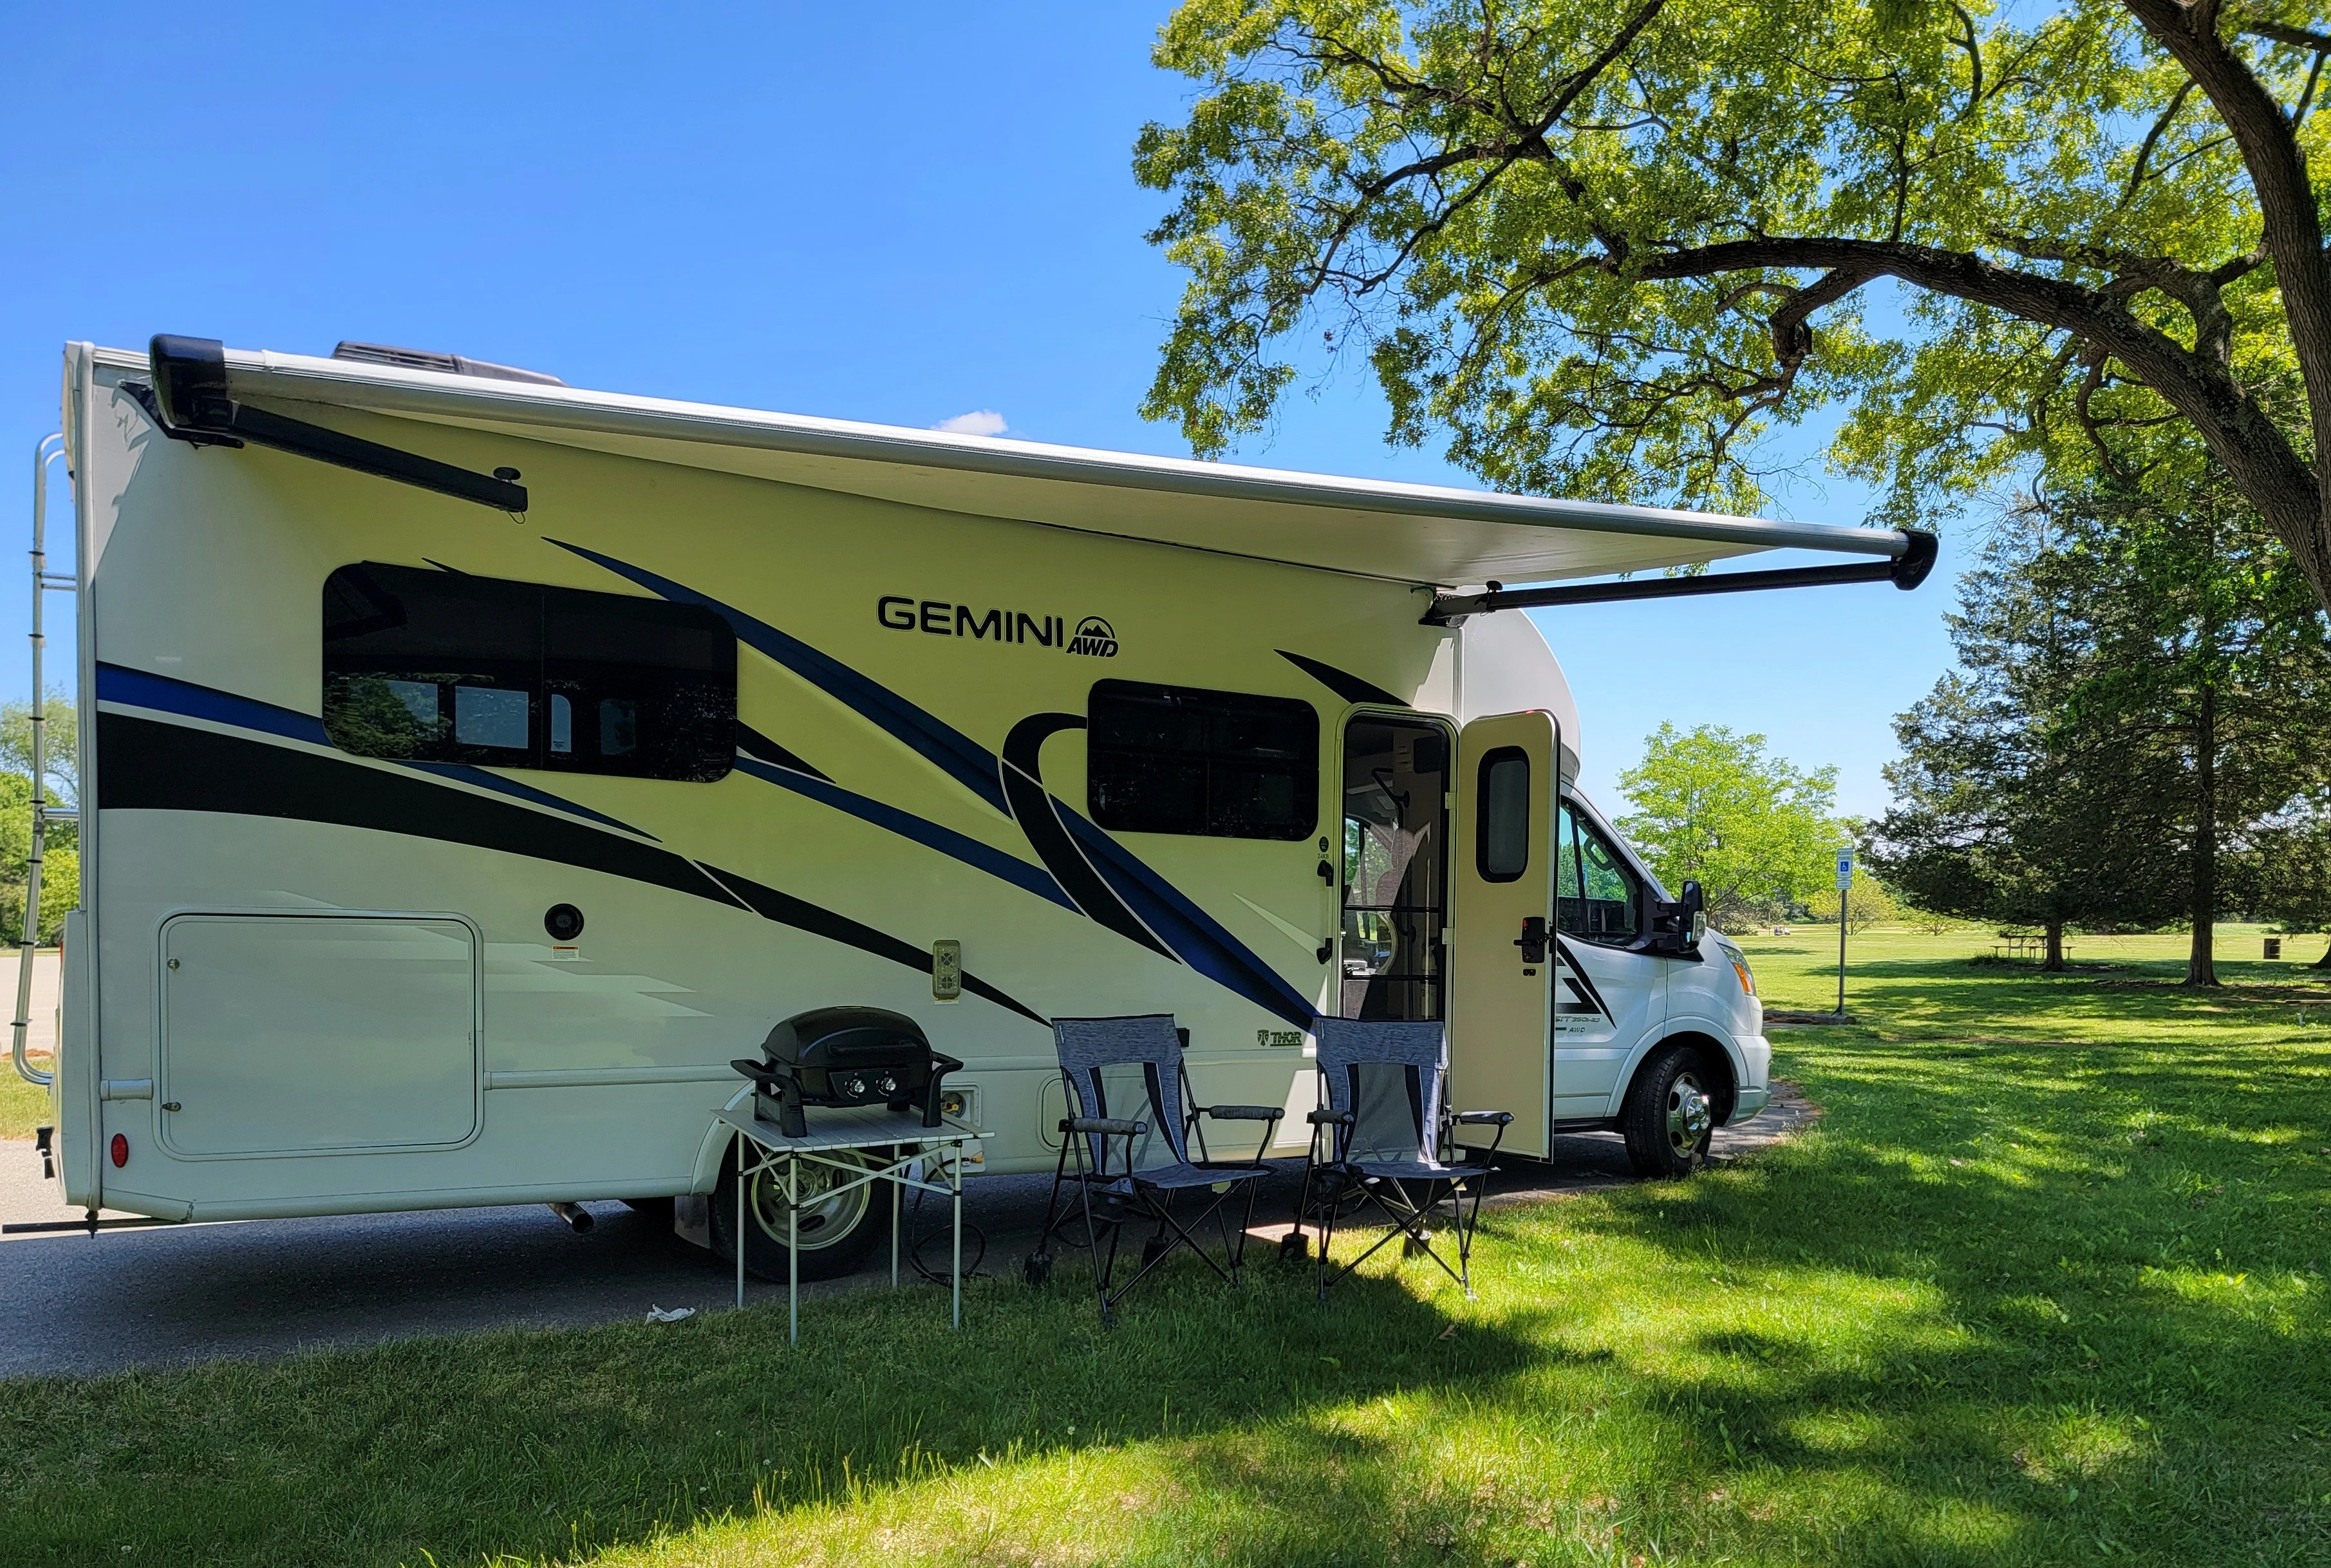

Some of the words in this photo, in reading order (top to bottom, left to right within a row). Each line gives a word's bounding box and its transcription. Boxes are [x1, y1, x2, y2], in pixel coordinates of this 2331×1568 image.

[877, 595, 1064, 648] GEMINI
[1065, 636, 1119, 658] AWD
[1270, 1031, 1302, 1043] THOR
